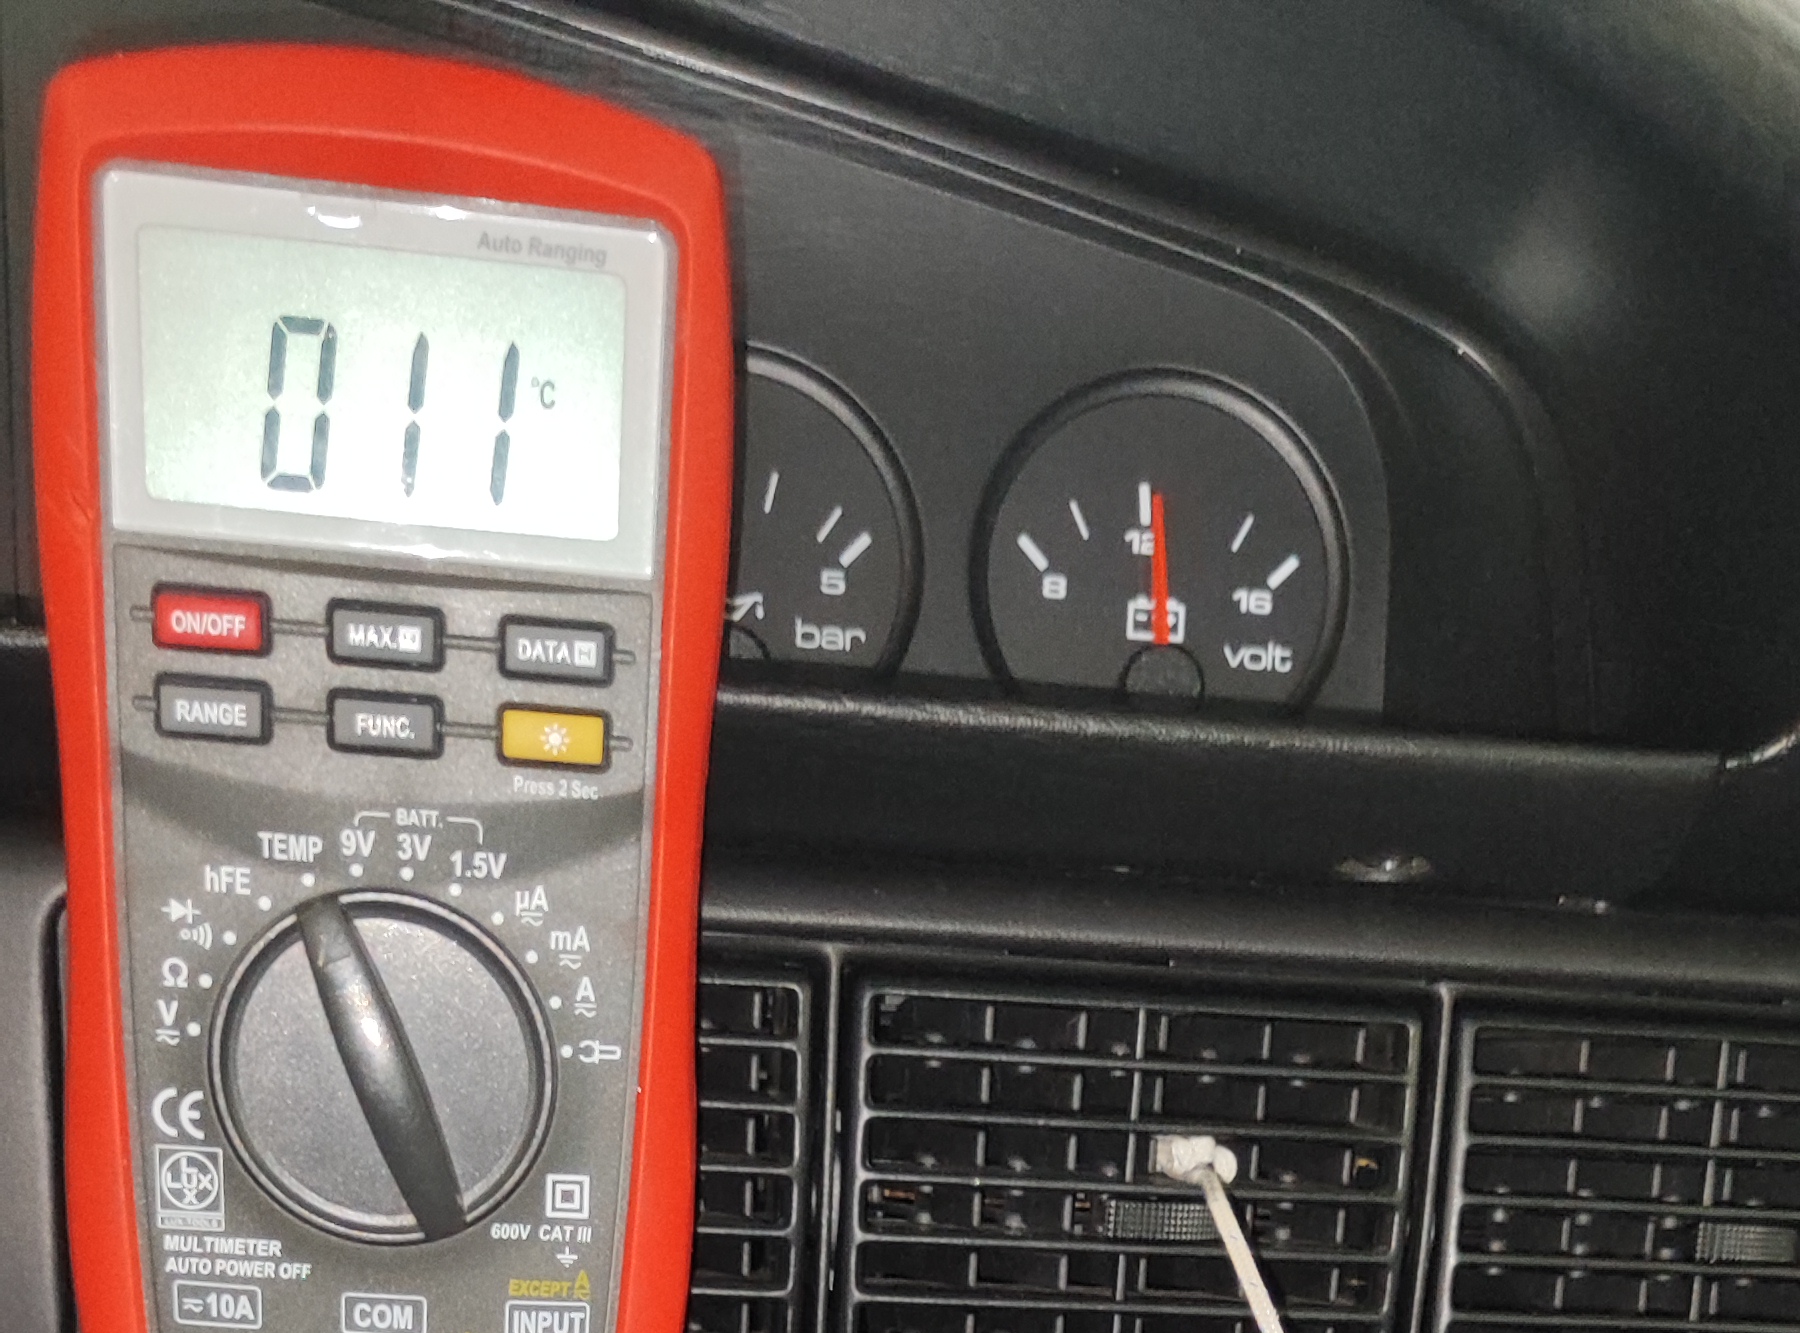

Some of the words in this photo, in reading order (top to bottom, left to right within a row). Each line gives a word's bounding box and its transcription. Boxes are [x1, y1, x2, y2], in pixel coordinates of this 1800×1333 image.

[477, 231, 522, 254] Auto
[529, 236, 608, 268] Ranging
[261, 316, 519, 505] 011
[531, 376, 556, 409] °C
[820, 568, 847, 595] 5
[1042, 572, 1068, 600] 8
[1232, 588, 1274, 616] 16
[170, 610, 247, 639] ON/OFF
[795, 616, 867, 652] bar
[517, 638, 571, 666] DATA
[1223, 641, 1294, 674] volt
[175, 700, 247, 728] RANGE
[356, 713, 416, 740] FUNC.
[513, 775, 555, 796] Press
[558, 779, 568, 796] 2
[571, 781, 599, 801] Sec
[396, 808, 443, 829] BATT.
[258, 831, 323, 863] TEMP
[340, 831, 375, 857] 9V
[398, 832, 432, 861] 3V
[449, 850, 507, 879] 1.5V
[204, 865, 251, 896] hFE
[514, 885, 549, 917] µA
[549, 925, 591, 953] mA
[161, 957, 189, 988] Ω
[576, 976, 596, 1002] A
[157, 999, 179, 1027] V
[152, 1086, 206, 1141] CE
[163, 1234, 282, 1258] MULTIMETER
[490, 1222, 531, 1241] 600V
[538, 1224, 574, 1242] CAT
[576, 1225, 592, 1243] III
[165, 1256, 212, 1276] AUTO
[214, 1258, 276, 1279] POWER
[278, 1262, 313, 1280] OFF
[508, 1278, 572, 1298] EXCEPT
[352, 1302, 414, 1330] COM
